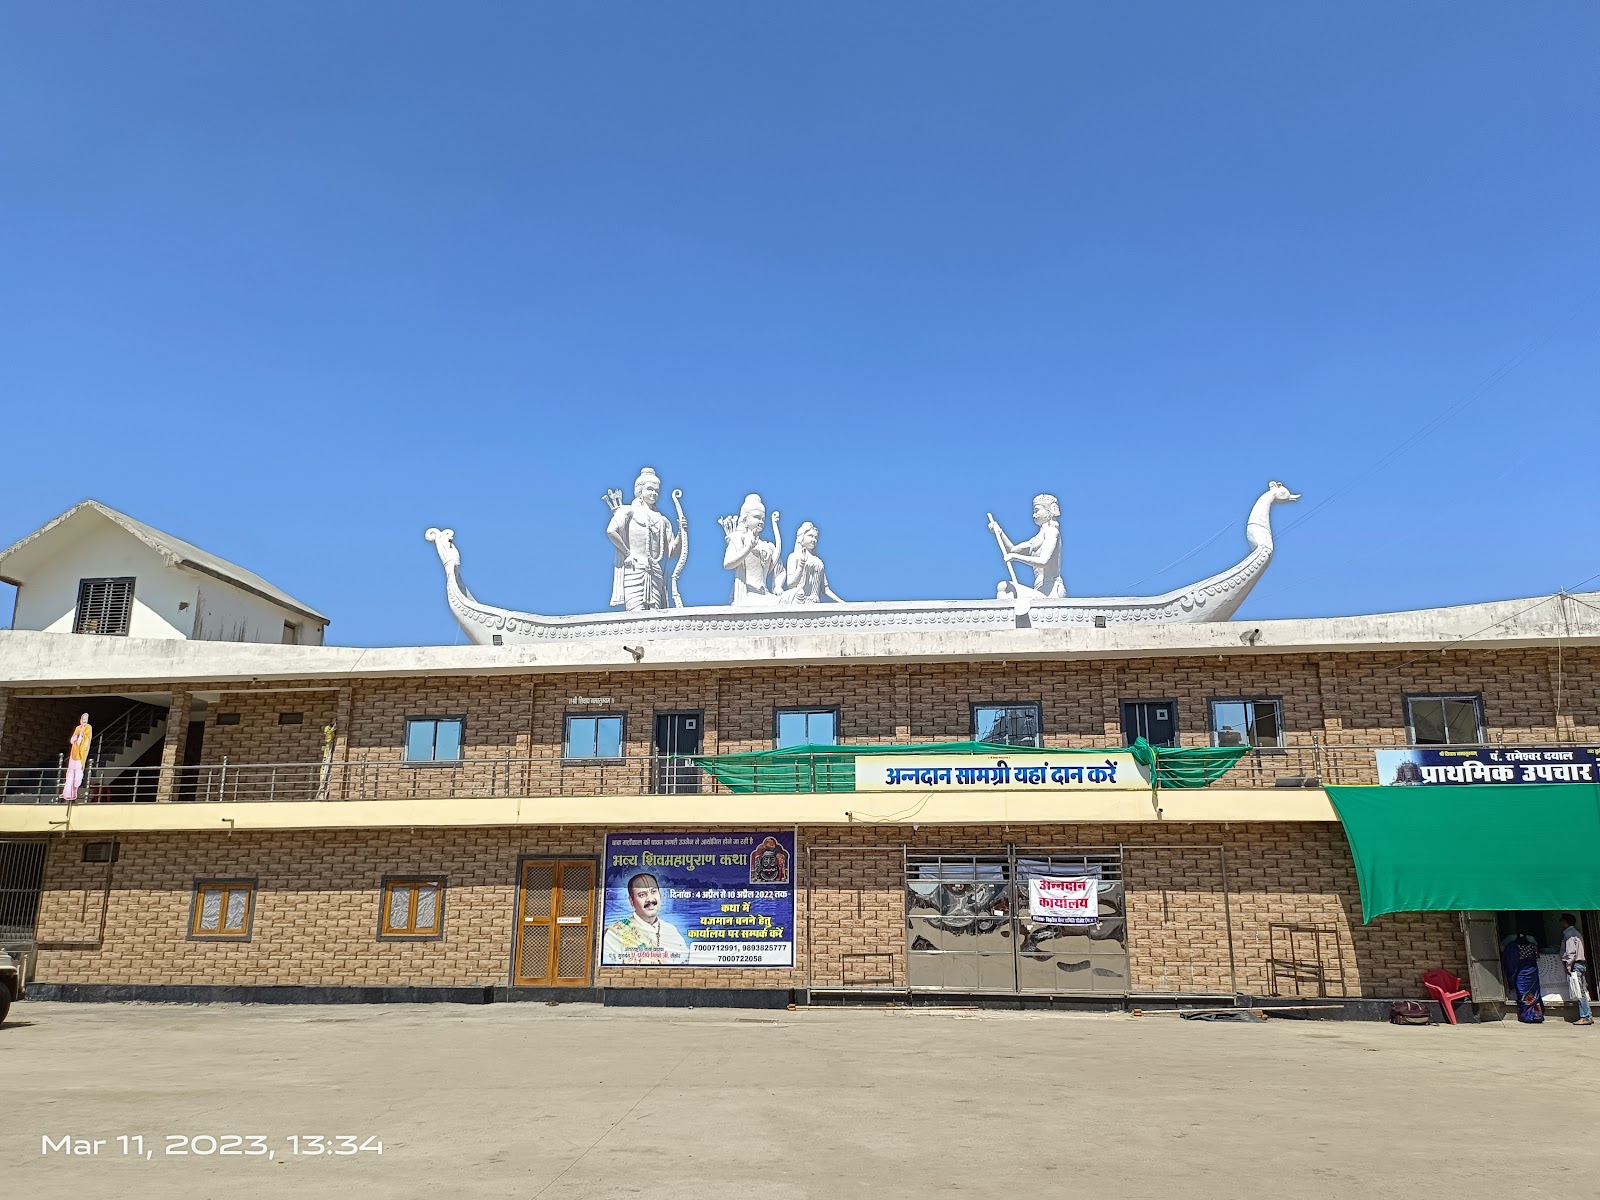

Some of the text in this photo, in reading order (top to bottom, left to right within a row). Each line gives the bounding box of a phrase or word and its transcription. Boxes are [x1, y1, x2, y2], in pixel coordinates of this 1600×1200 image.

[1506, 751, 1541, 761] रामेश्वर
[1544, 751, 1573, 760] दयाल
[885, 760, 1118, 786] अन्नदान सामग्री यहां दान करें
[1419, 760, 1514, 784] प्राथमिक
[1519, 763, 1592, 782] उपचार
[612, 851, 747, 871] भव्य शिवमहापुराण कथा
[1040, 880, 1086, 892] अन्नदान
[702, 889, 719, 899] अप्रैल
[720, 889, 726, 898] से
[736, 889, 754, 898] अप्रैल
[721, 902, 751, 912] कथा में
[1039, 896, 1088, 908] कार्यालय
[700, 916, 733, 925] यजमान
[758, 915, 772, 927] हेतु
[688, 927, 784, 938] कार्यालय पर सम्पर्क करें
